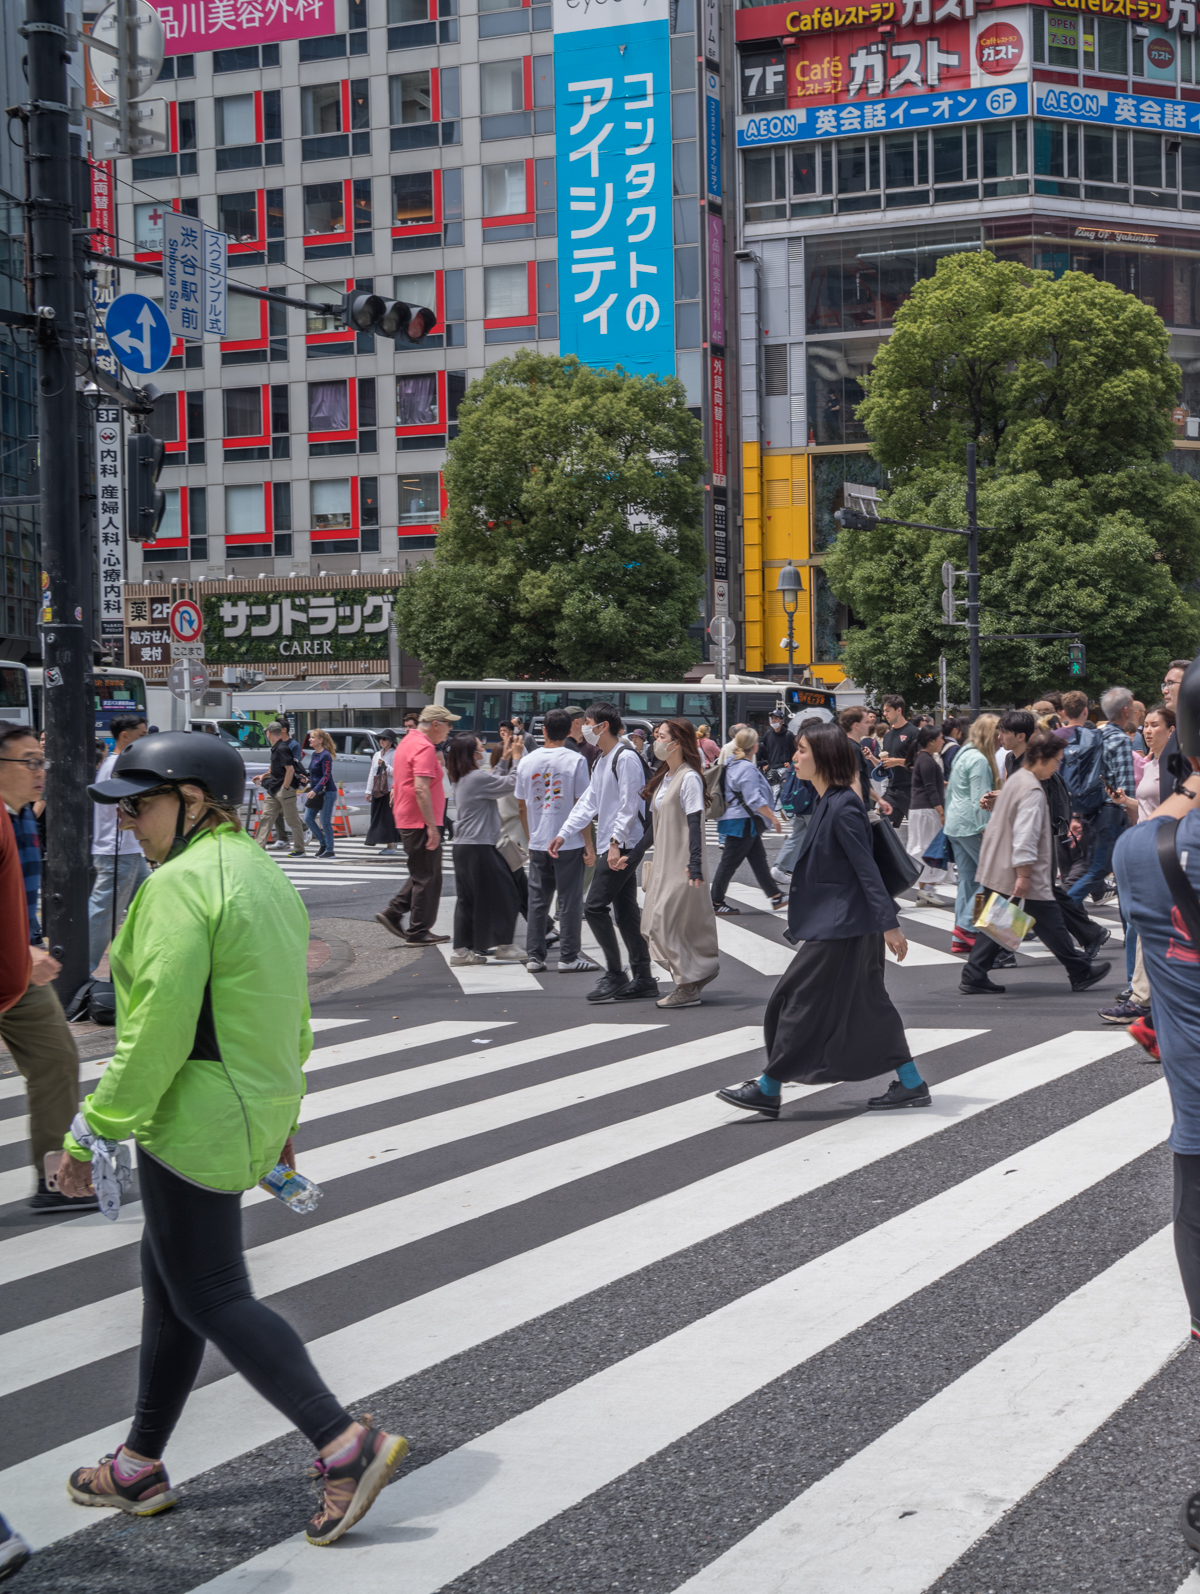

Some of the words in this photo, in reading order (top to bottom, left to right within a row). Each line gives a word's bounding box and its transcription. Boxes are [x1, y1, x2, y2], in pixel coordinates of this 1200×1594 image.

[1050, 17, 1076, 30] OPEN
[1050, 33, 1076, 47] 7:30
[982, 45, 1019, 62] ガスト
[1151, 51, 1172, 61] ガスト
[744, 64, 785, 96] 7F
[795, 56, 842, 82] Café
[848, 40, 960, 99] ガスト
[797, 81, 842, 97] レストラン
[990, 92, 1012, 110] 6F
[1044, 90, 1099, 115] AEON
[815, 95, 978, 135] 英会話イーオン
[745, 115, 797, 139] AEON
[568, 78, 618, 334] アイシティ
[624, 73, 660, 332] コンタクトの
[1074, 228, 1095, 240] King
[167, 238, 179, 285] Shibuya
[181, 226, 199, 330] 渋谷駅前
[208, 235, 223, 332] スクランブル式
[169, 290, 179, 313] Sta.
[712, 330, 722, 341] 4F
[98, 410, 118, 422] 3F
[100, 449, 119, 478] 内科
[100, 484, 120, 546] 産婦人科
[102, 549, 123, 615] 心療内科
[131, 601, 148, 621] 薬
[152, 603, 171, 618] 2F
[219, 594, 395, 638] サンドラッグ
[130, 630, 171, 644] 処方せん
[279, 640, 334, 656] CARER
[141, 647, 163, 661] 受付
[173, 646, 202, 656] ここまで
